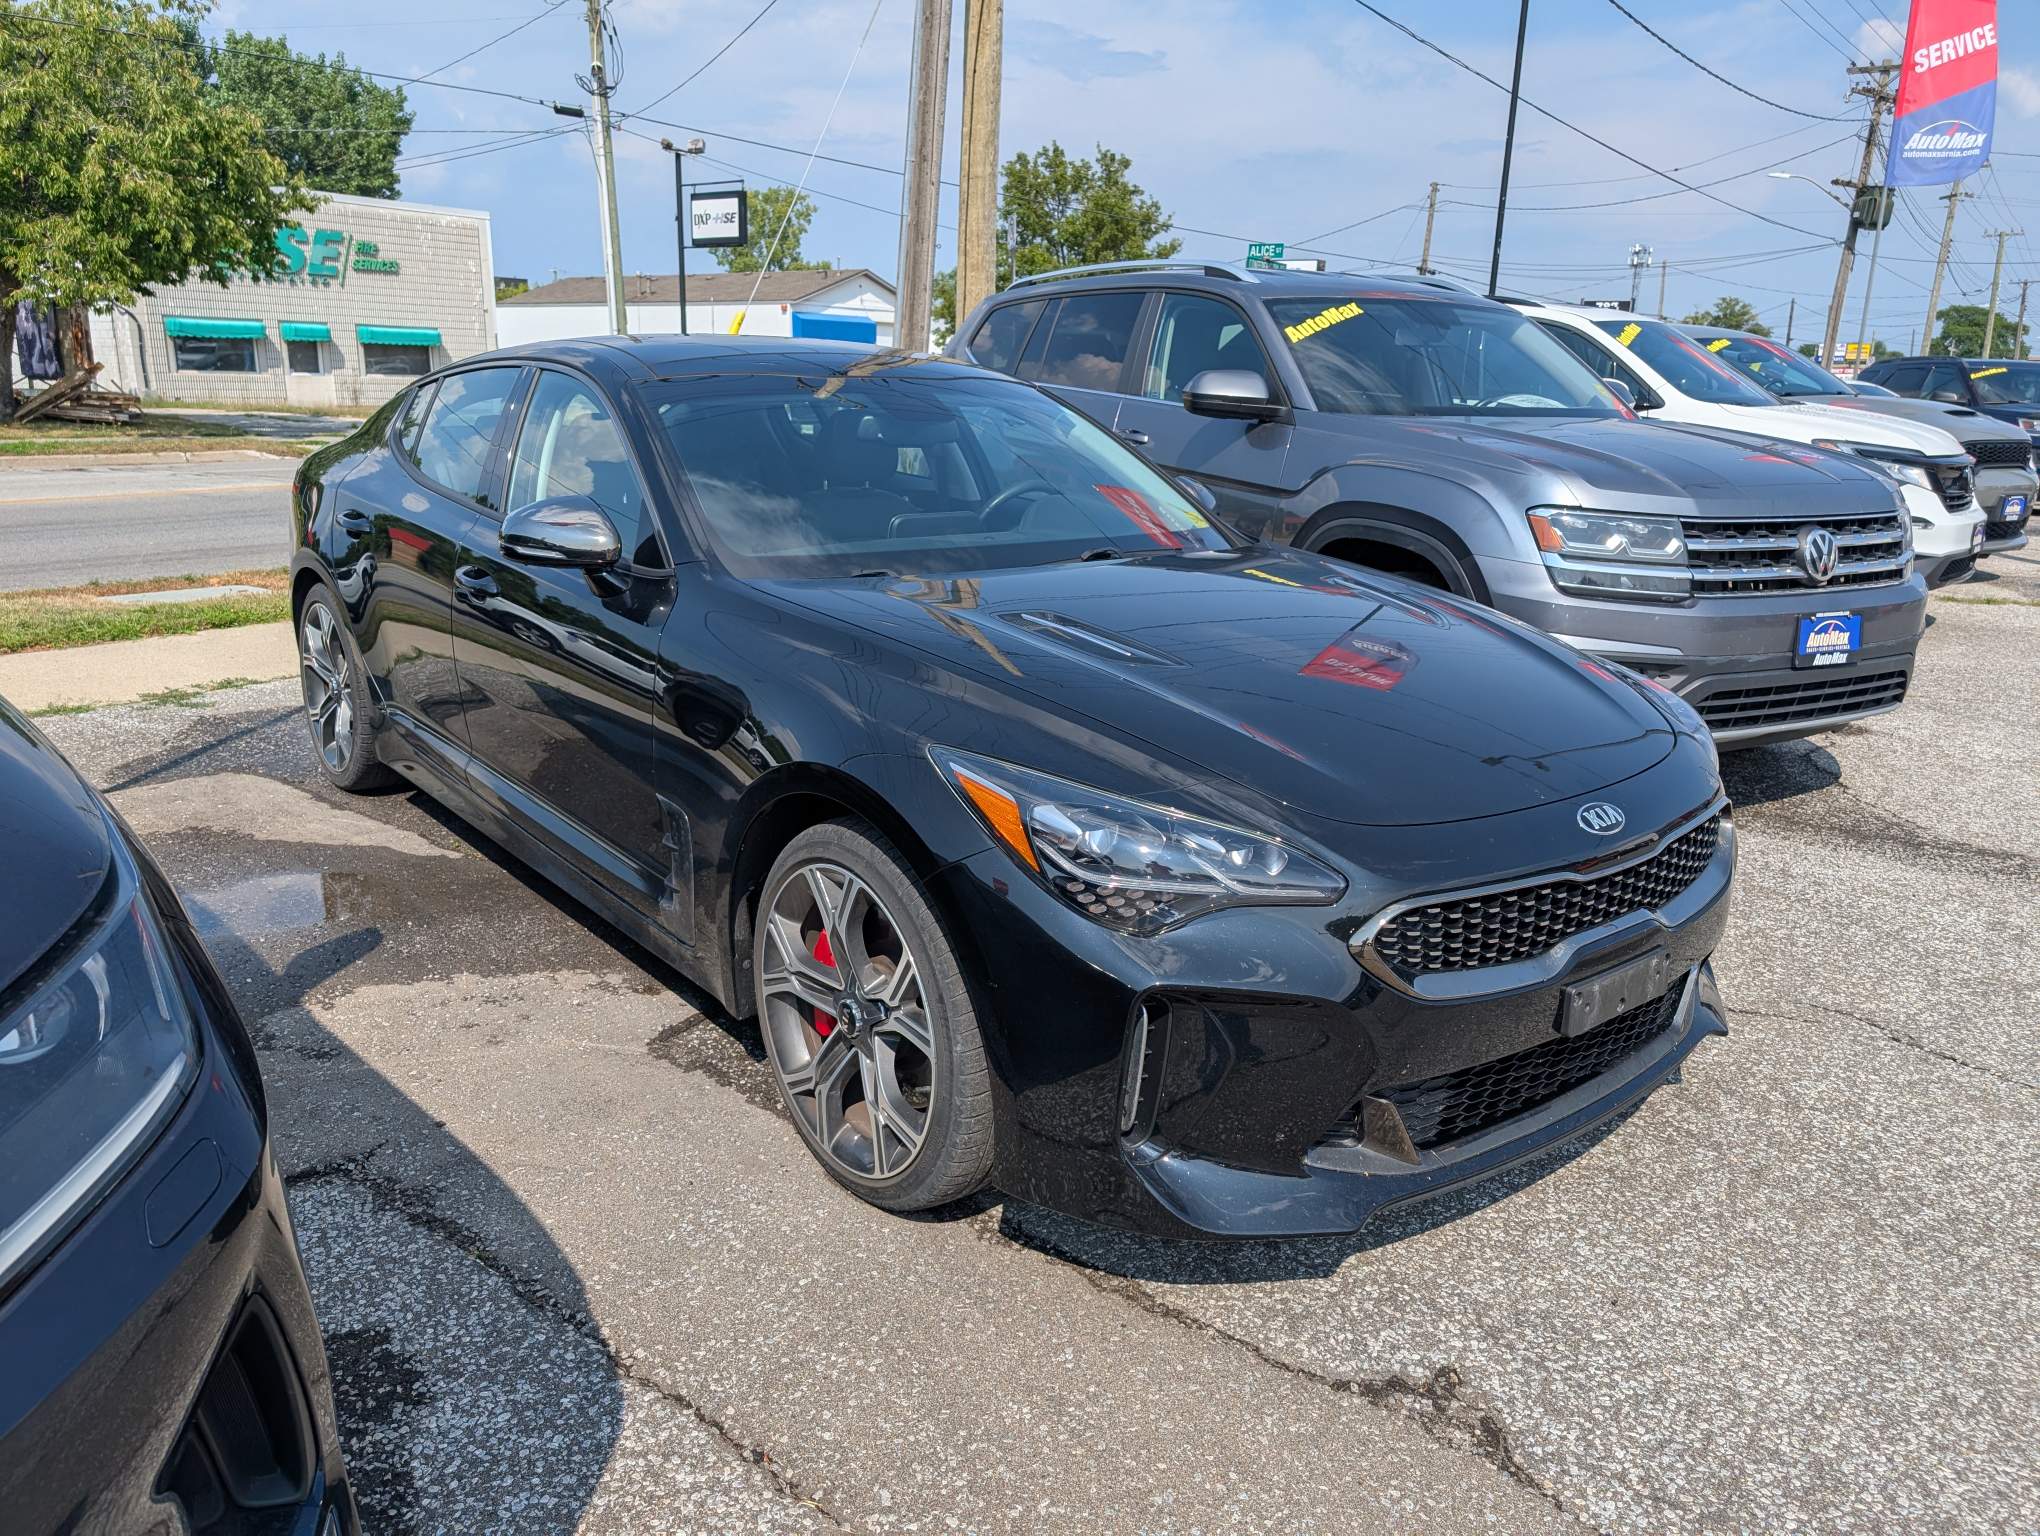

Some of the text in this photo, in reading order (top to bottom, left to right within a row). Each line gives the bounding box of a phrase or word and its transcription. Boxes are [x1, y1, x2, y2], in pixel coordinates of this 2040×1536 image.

[1914, 23, 1997, 73] SERVICE
[1904, 132, 1987, 149] AutoMax
[694, 211, 711, 227] DXP
[1250, 245, 1275, 257] ALICE
[352, 258, 399, 272] SERVICES
[1284, 302, 1364, 344] AutoMax
[1806, 630, 1850, 647] AutoMax
[1813, 652, 1848, 666] AutoMax
[1582, 805, 1622, 829] KIA
